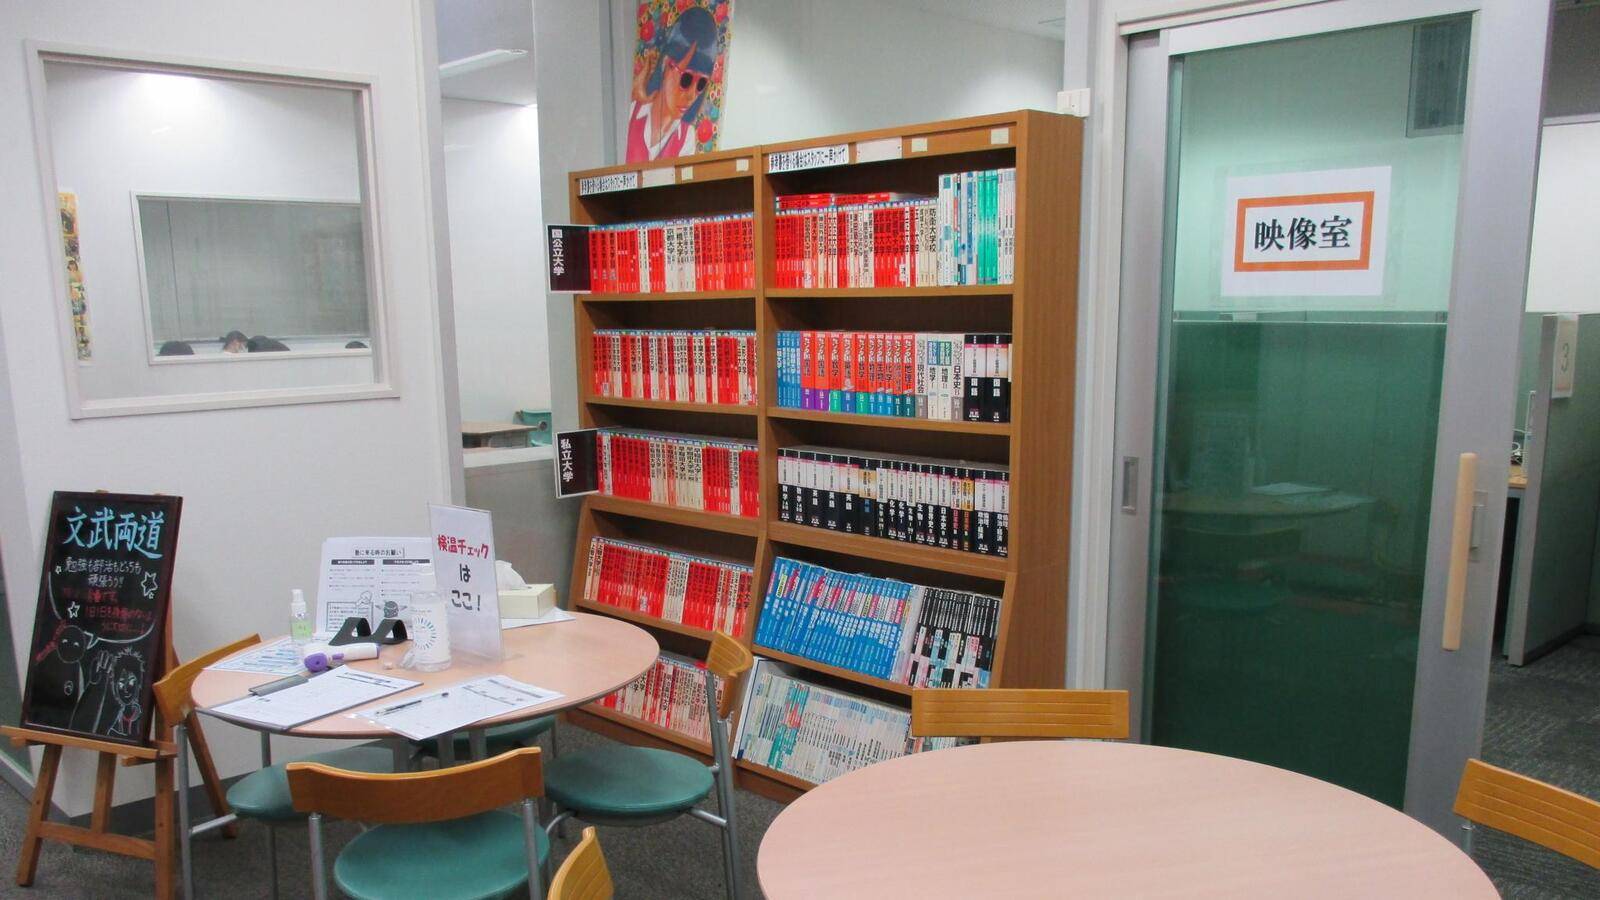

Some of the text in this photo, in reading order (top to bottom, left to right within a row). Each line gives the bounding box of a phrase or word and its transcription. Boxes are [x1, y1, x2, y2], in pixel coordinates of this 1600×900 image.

[551, 229, 565, 276] 国公立大学
[1254, 215, 1352, 252] 映像室
[560, 438, 574, 483] 私立大学
[62, 506, 165, 559] 文武両道
[437, 534, 489, 559] 検温チェック
[459, 563, 471, 583] は
